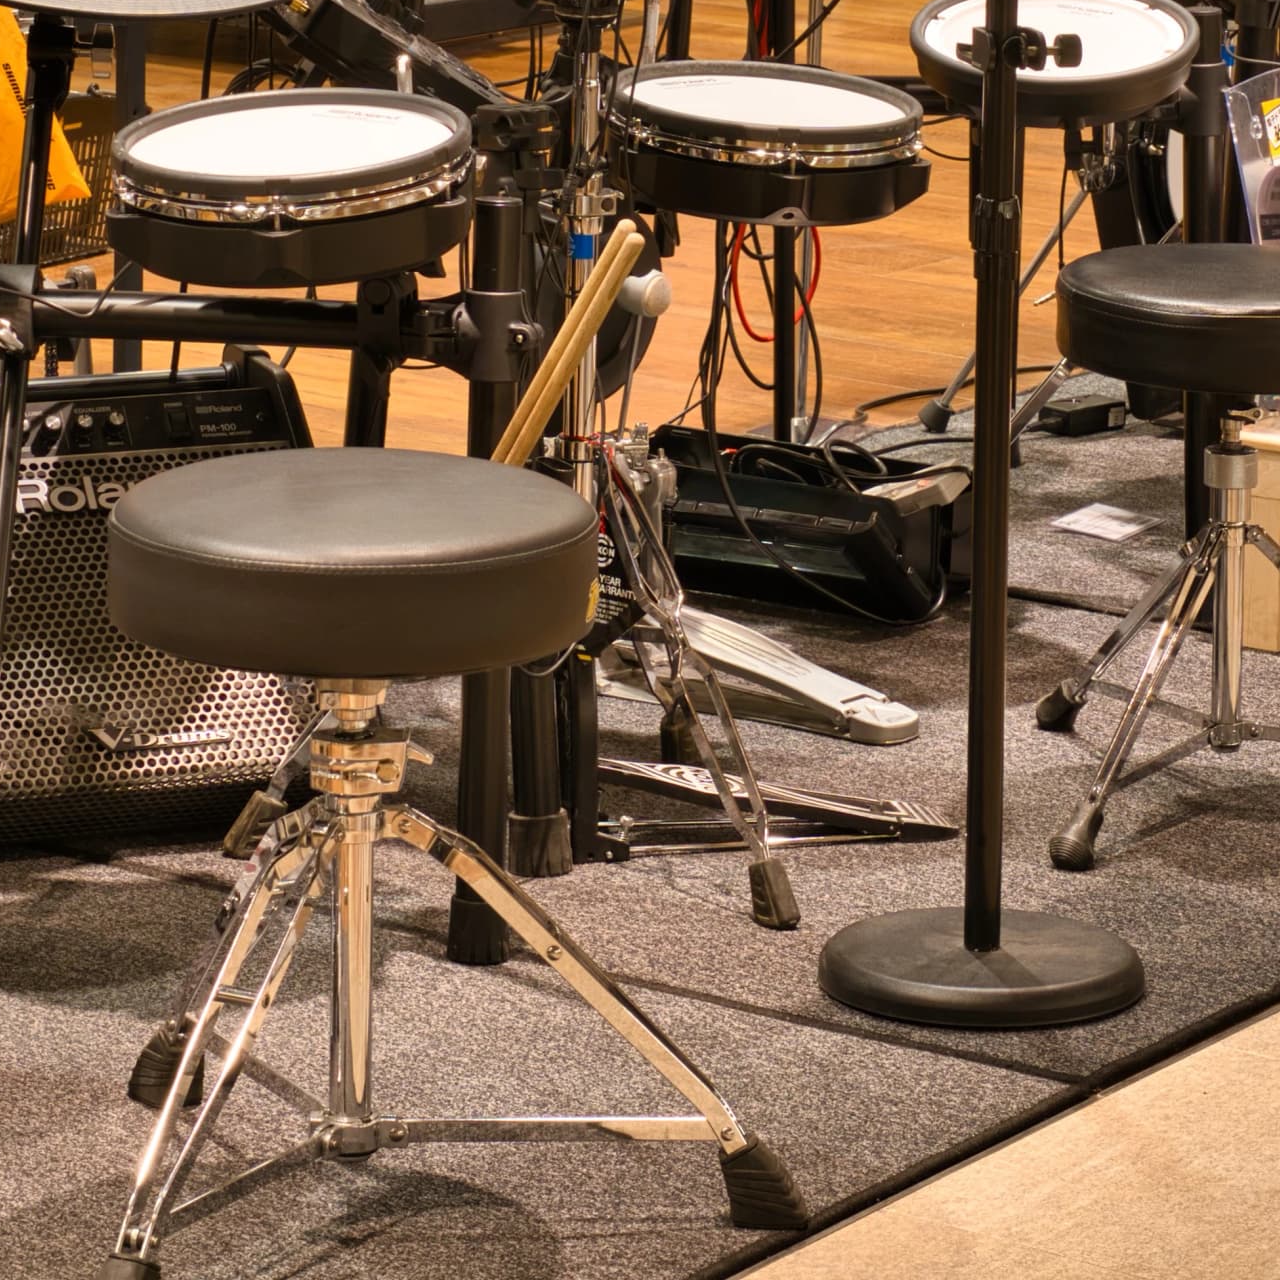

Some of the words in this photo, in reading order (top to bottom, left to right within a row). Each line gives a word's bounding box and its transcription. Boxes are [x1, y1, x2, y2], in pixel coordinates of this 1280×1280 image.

[208, 403, 243, 413] Roland
[200, 422, 237, 434] PM-100
[16, 475, 135, 514] Rola
[89, 725, 231, 750] V-Drums
